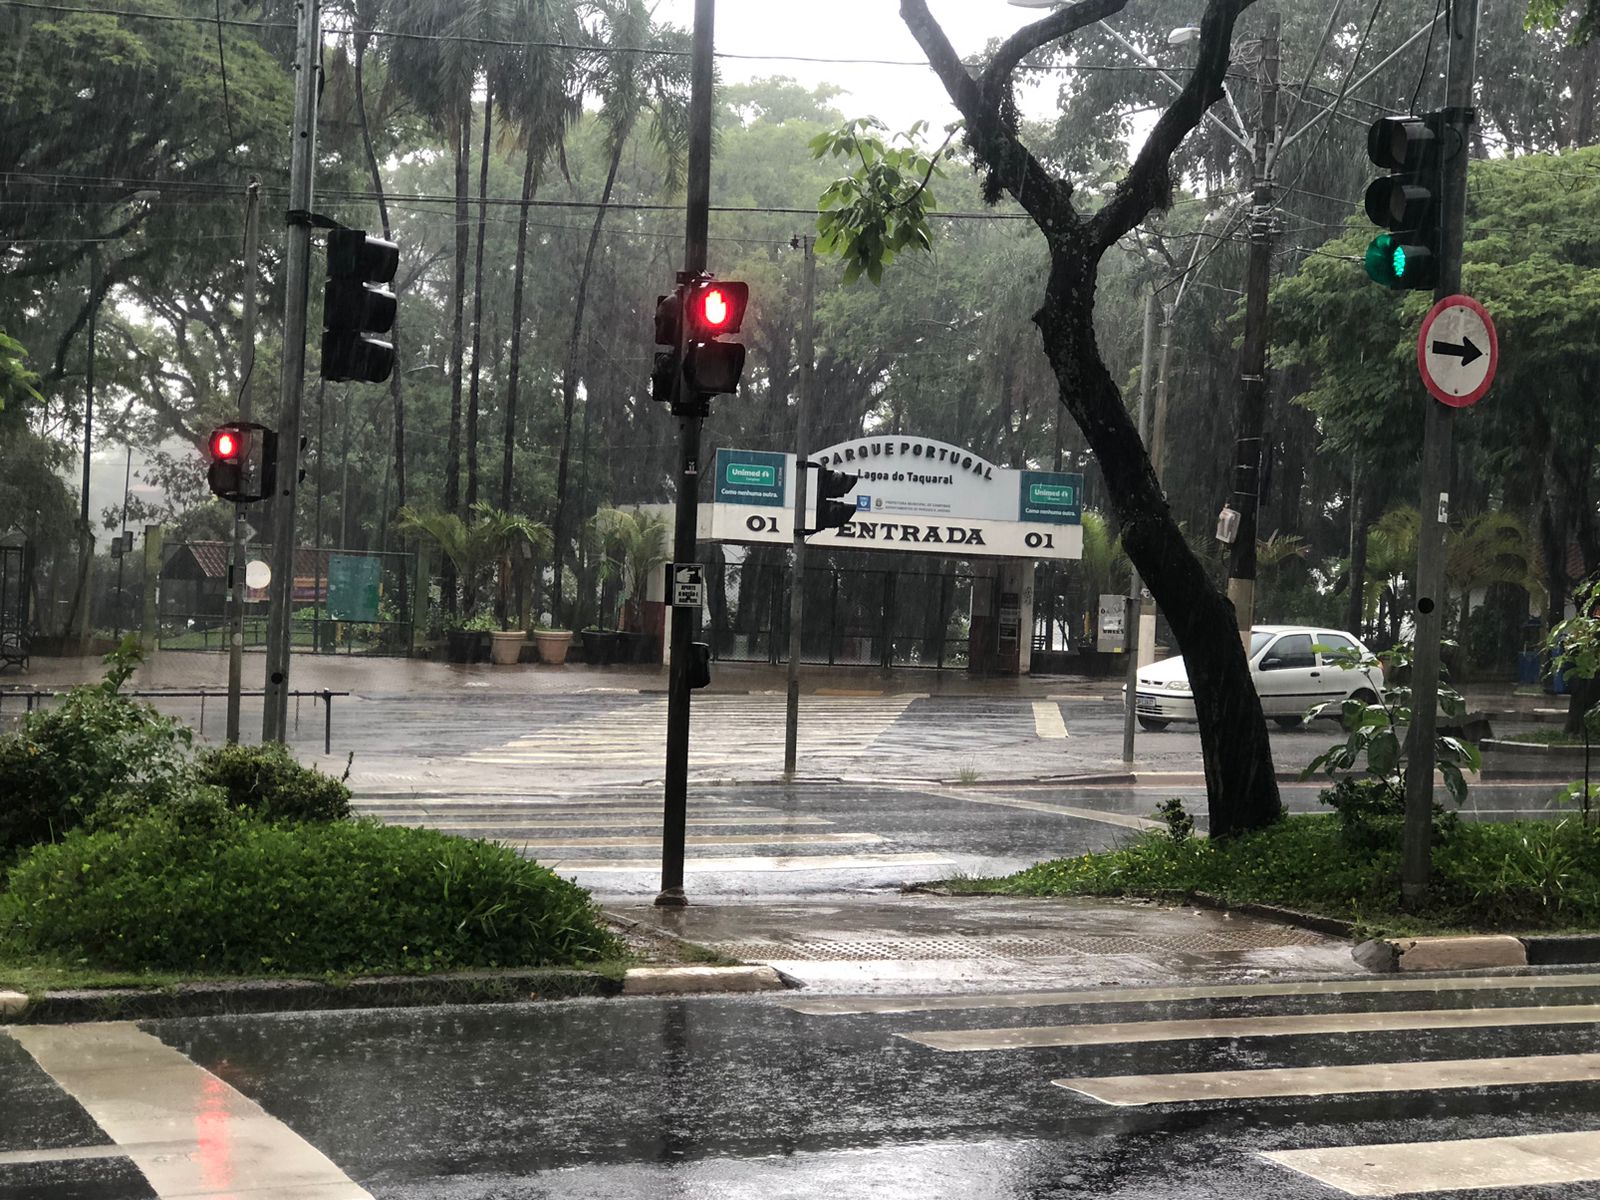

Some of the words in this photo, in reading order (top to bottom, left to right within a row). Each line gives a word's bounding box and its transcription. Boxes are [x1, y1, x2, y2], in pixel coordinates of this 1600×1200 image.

[820, 443, 894, 467] PARQUE
[900, 442, 992, 480] PORTUGAL
[732, 468, 760, 477] Unimed
[858, 469, 889, 482] Lagoa
[892, 471, 904, 481] do
[907, 471, 953, 485] Taquaral
[737, 489, 762, 497] nenhuma
[1034, 488, 1060, 497] Unimed
[746, 515, 780, 533] 01
[835, 521, 987, 545] ENTRADA
[1025, 532, 1055, 549] 01
